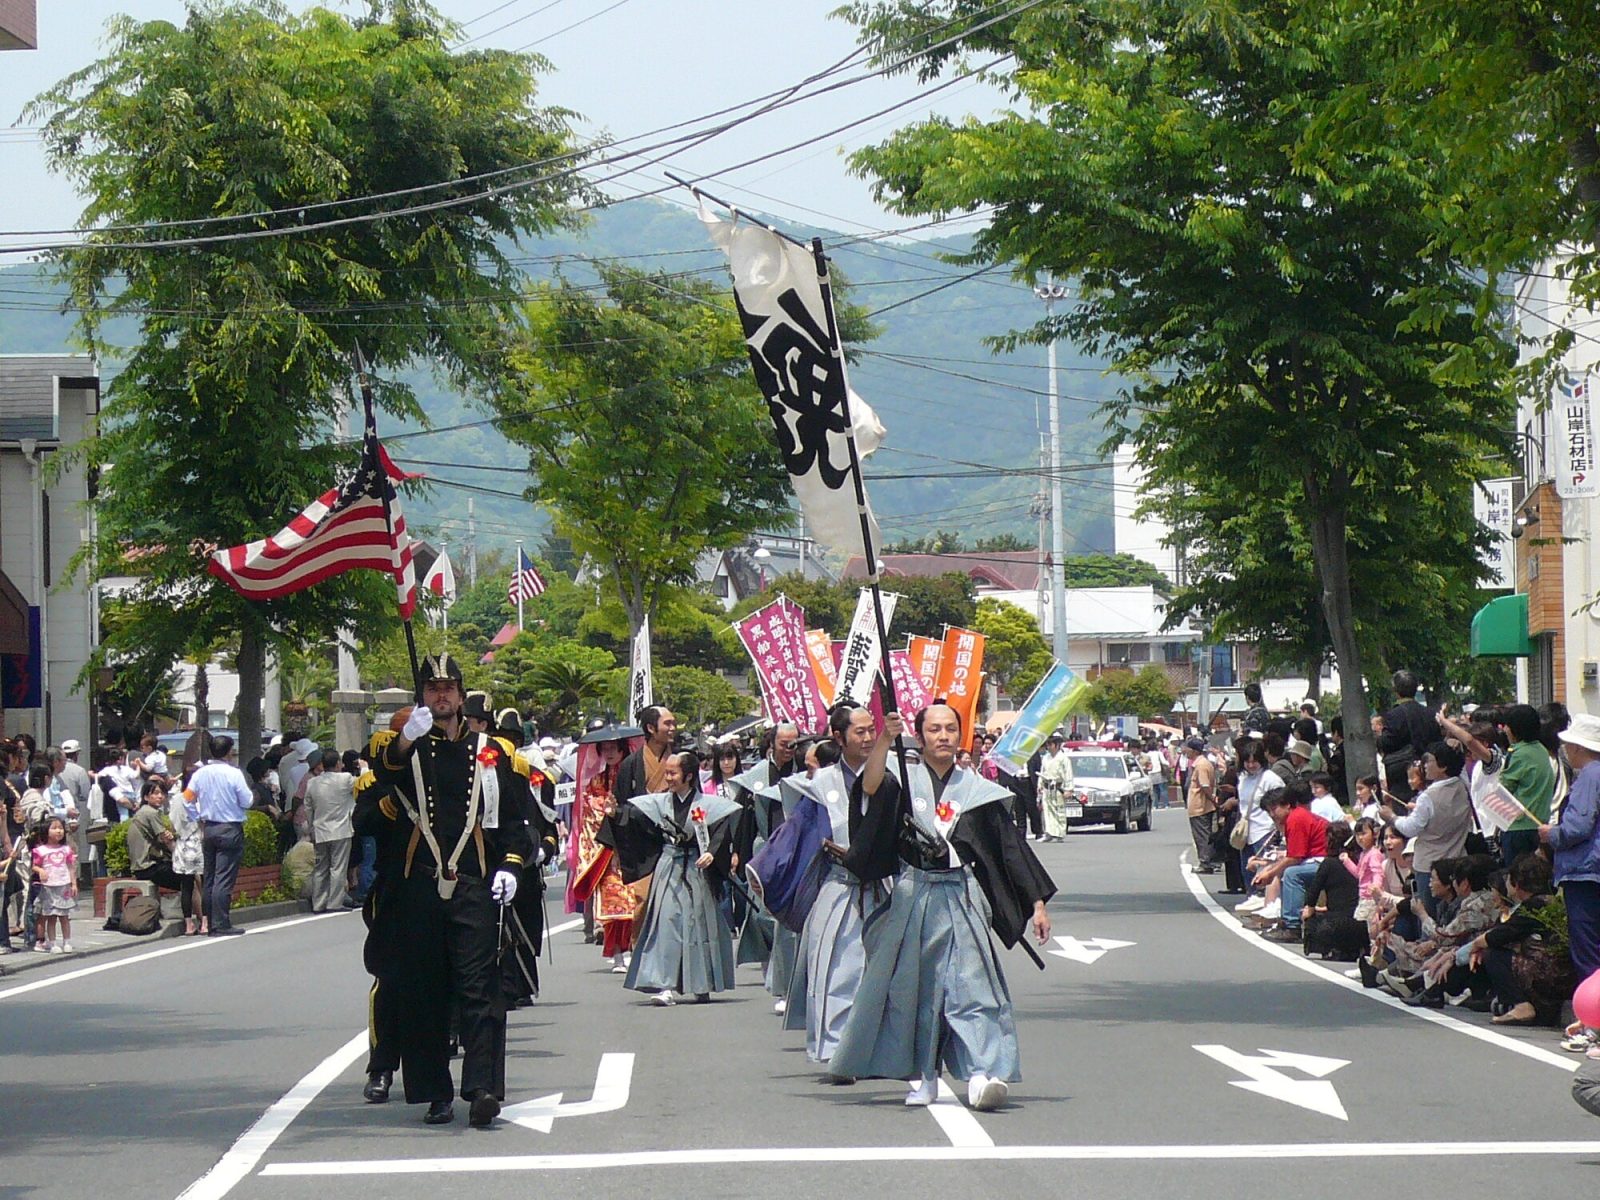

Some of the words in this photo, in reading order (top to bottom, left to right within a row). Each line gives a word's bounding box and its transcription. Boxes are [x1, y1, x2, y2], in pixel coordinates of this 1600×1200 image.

[1567, 405, 1586, 472] 山岸石材店
[1501, 488, 1510, 526] 司法書士
[920, 644, 940, 689] 開国の
[952, 633, 975, 697] 開国の地
